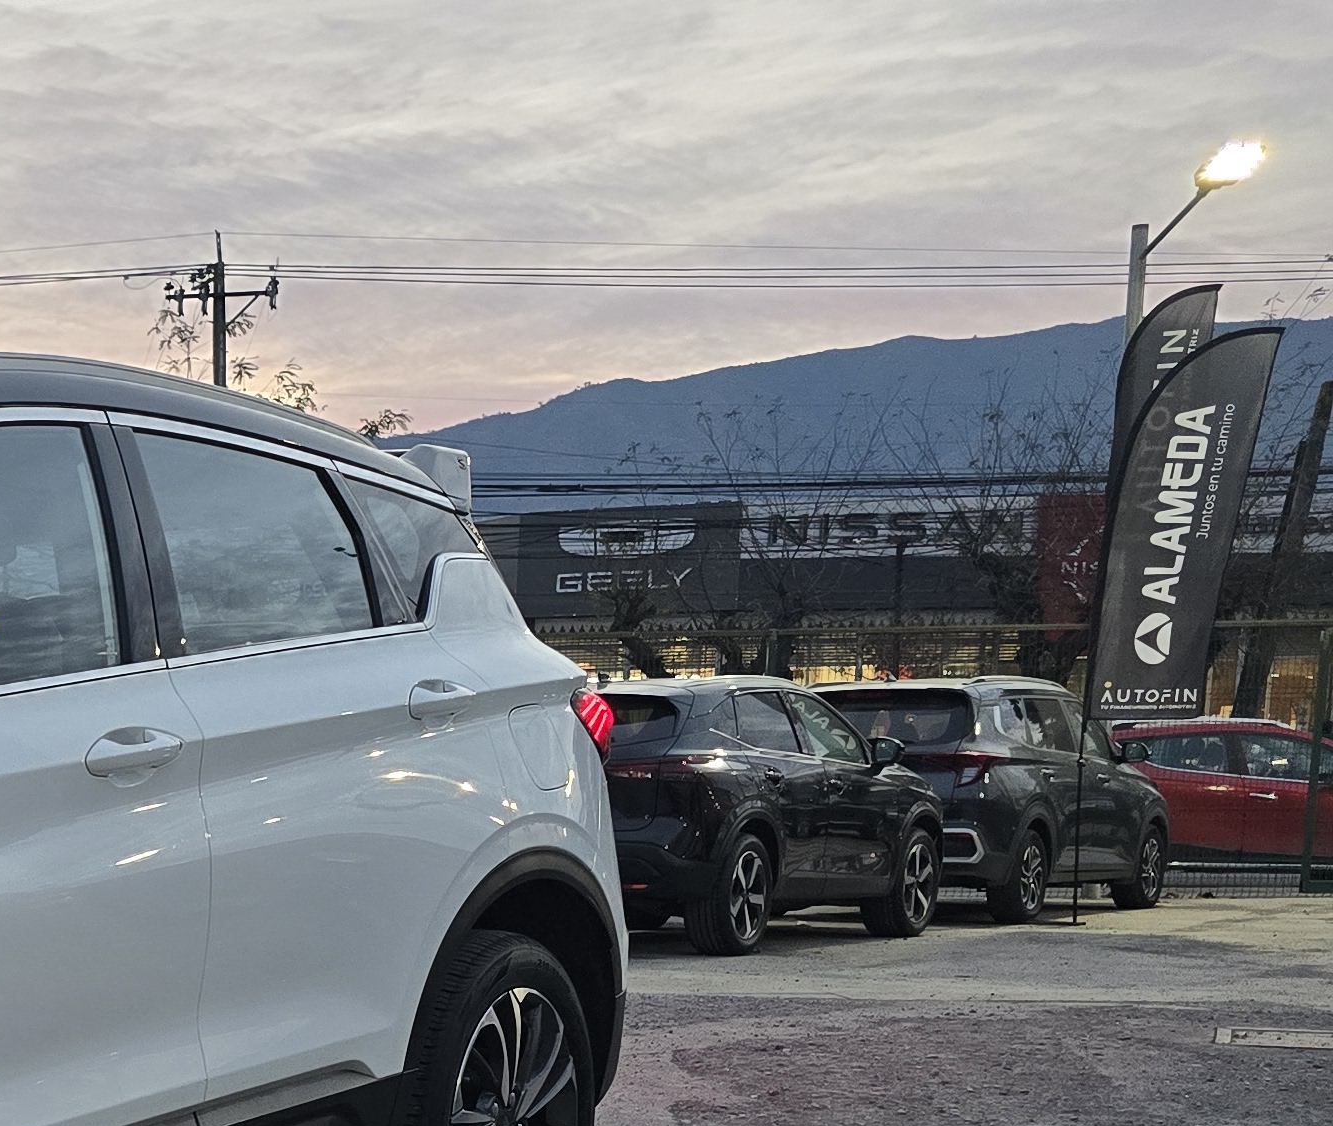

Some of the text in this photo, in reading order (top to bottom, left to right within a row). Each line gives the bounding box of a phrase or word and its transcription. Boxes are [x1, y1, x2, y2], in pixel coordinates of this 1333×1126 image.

[1141, 404, 1217, 605] ALAMEDA
[1196, 403, 1236, 539] Juntos en tu camino
[555, 567, 693, 593] GEELY
[1100, 687, 1198, 703] AUTOFIN
